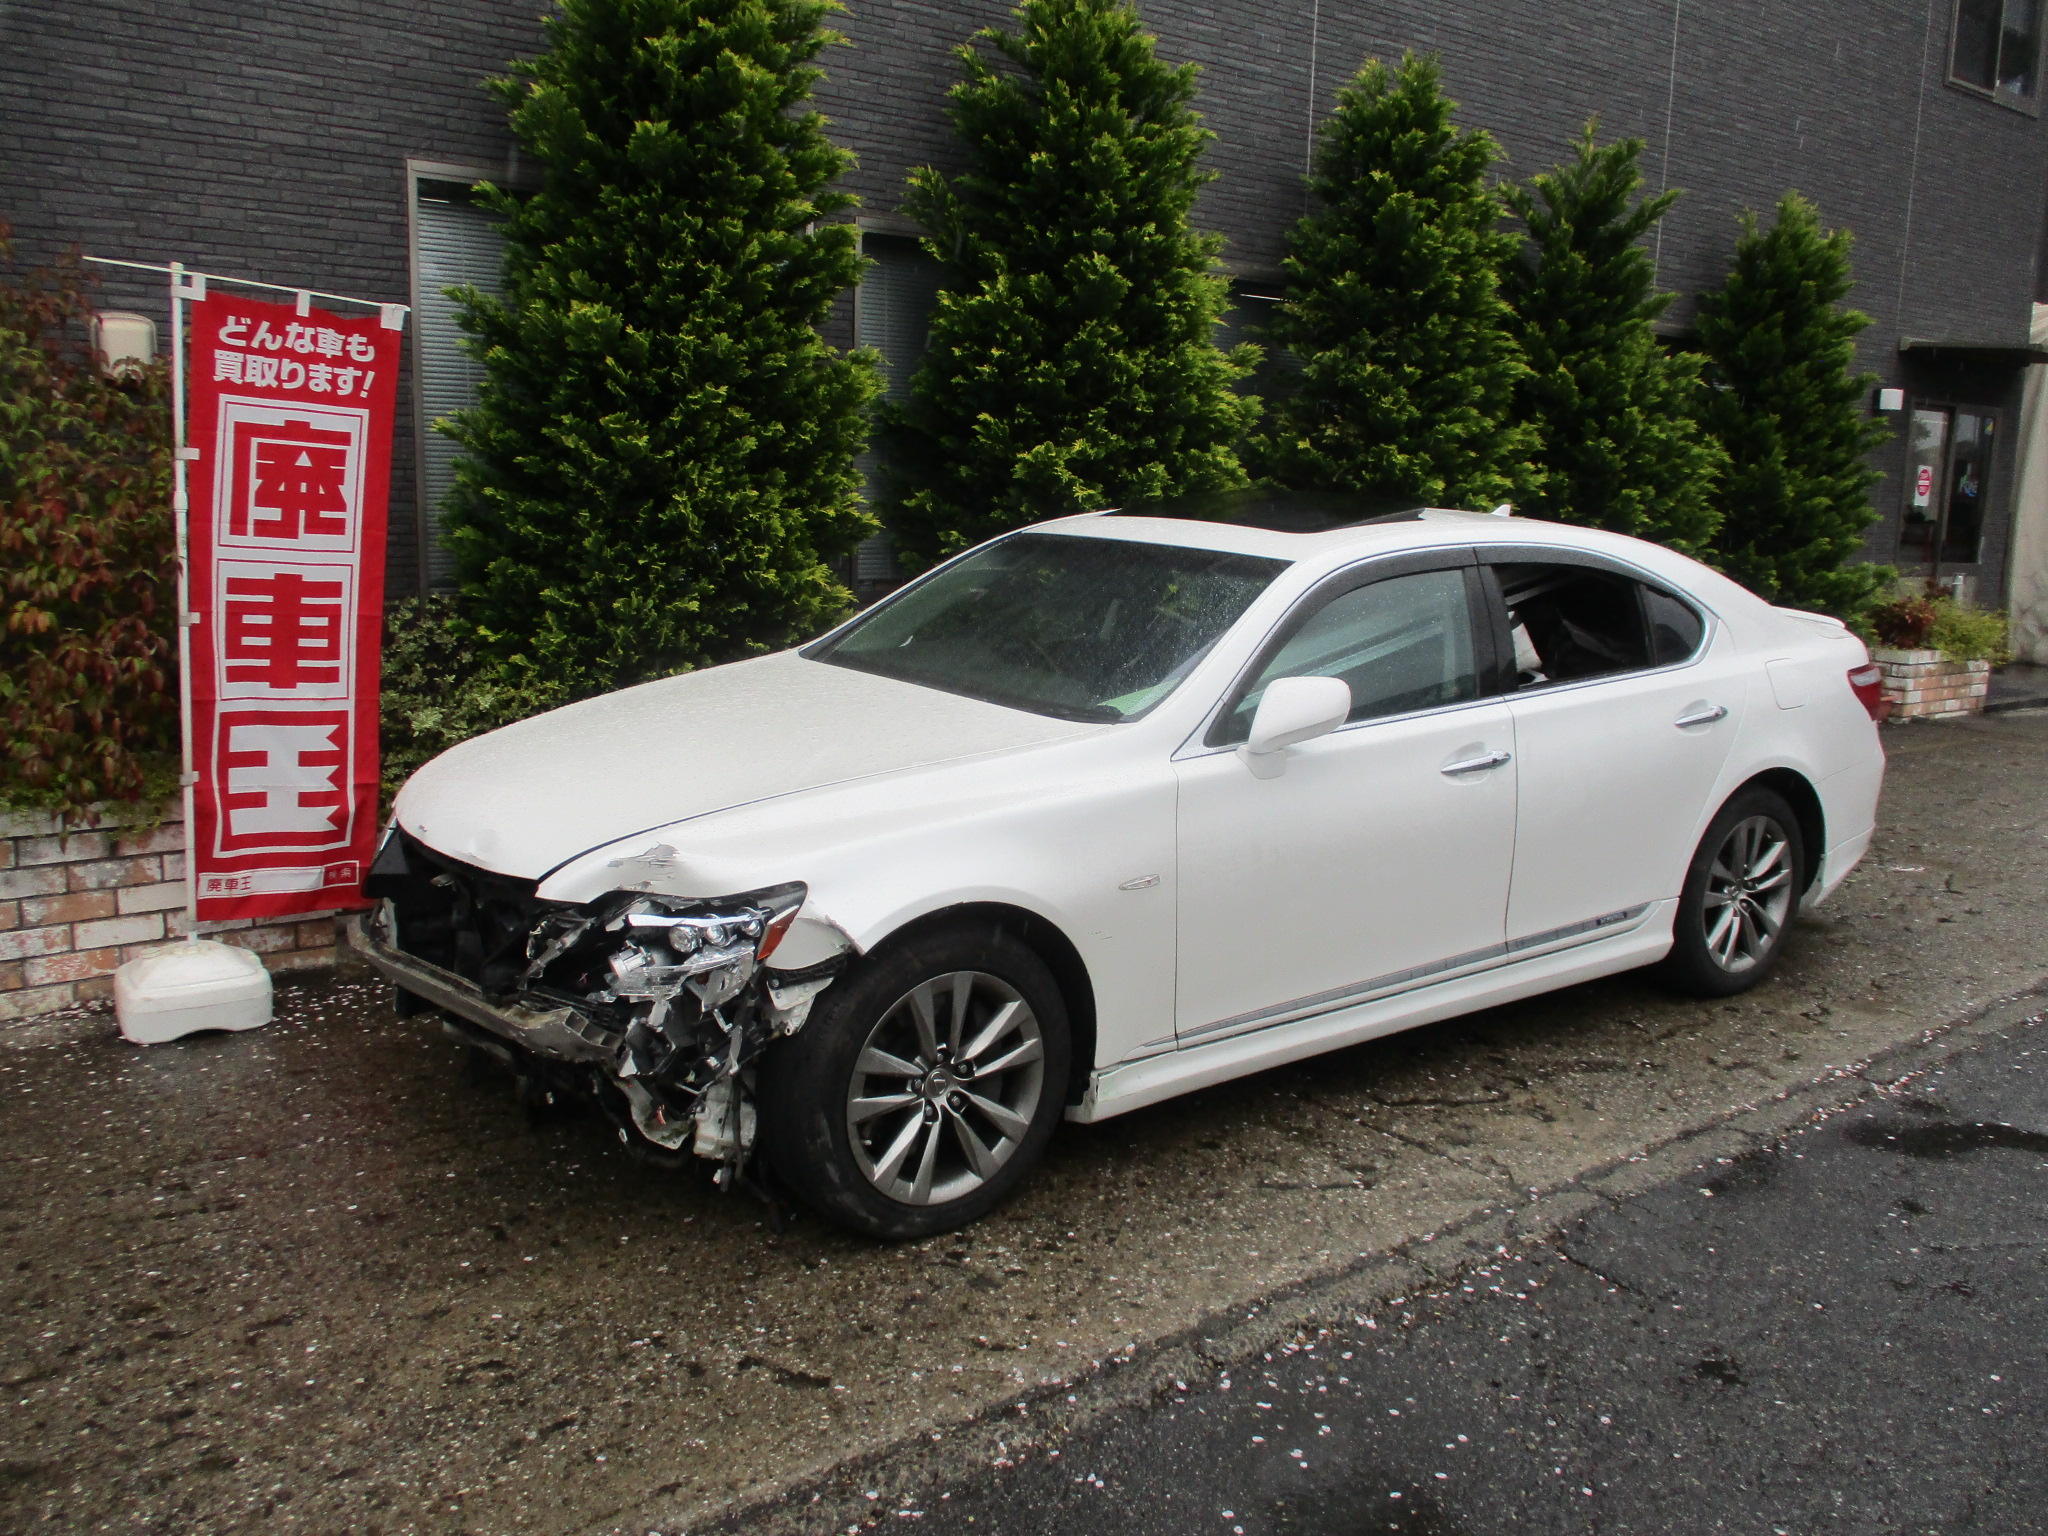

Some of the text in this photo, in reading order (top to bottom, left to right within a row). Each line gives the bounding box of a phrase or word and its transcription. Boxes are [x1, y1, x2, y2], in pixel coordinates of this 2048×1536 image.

[218, 315, 376, 362] どんな車も
[225, 419, 352, 836] 廃車王
[206, 875, 252, 892] 廃車王
